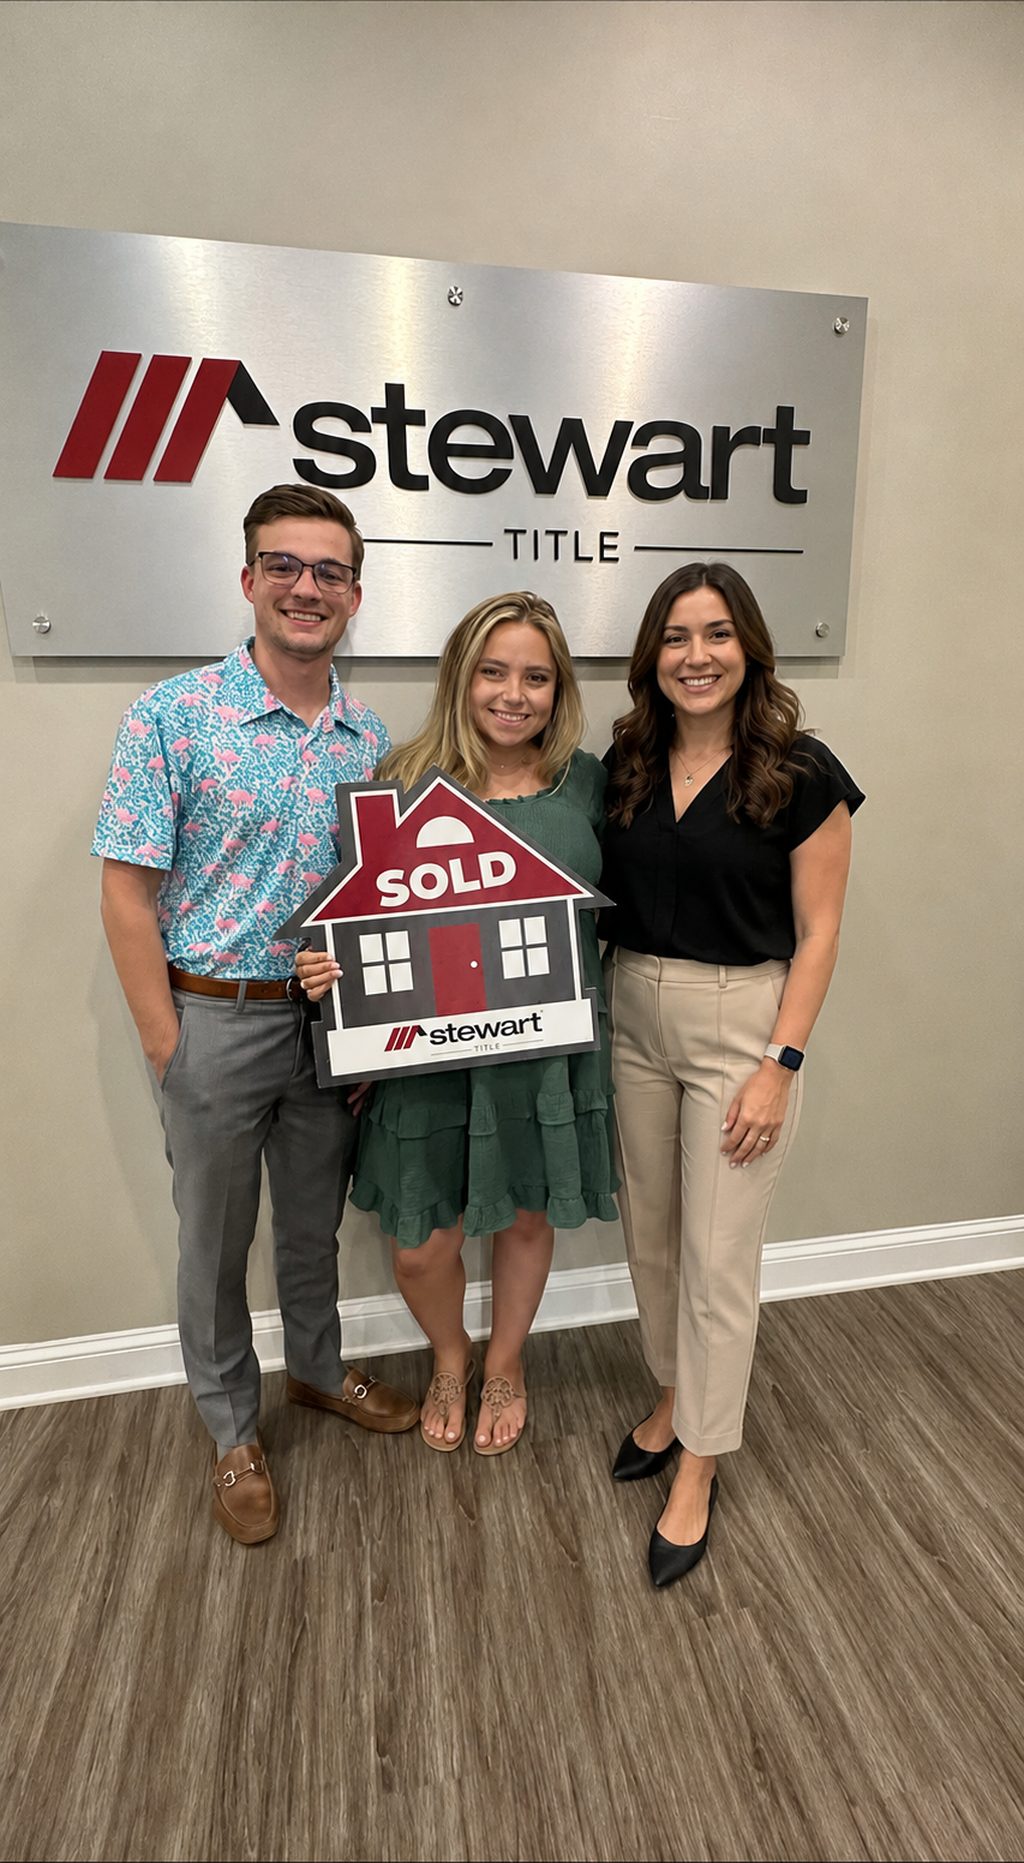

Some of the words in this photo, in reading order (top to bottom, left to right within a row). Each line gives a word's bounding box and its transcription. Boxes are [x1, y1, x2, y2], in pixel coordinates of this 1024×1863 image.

[292, 382, 811, 504] stewart
[503, 528, 621, 564] TITLE
[376, 851, 517, 907] SOLD
[429, 1012, 543, 1045] stewart
[474, 1042, 501, 1052] TITLE
